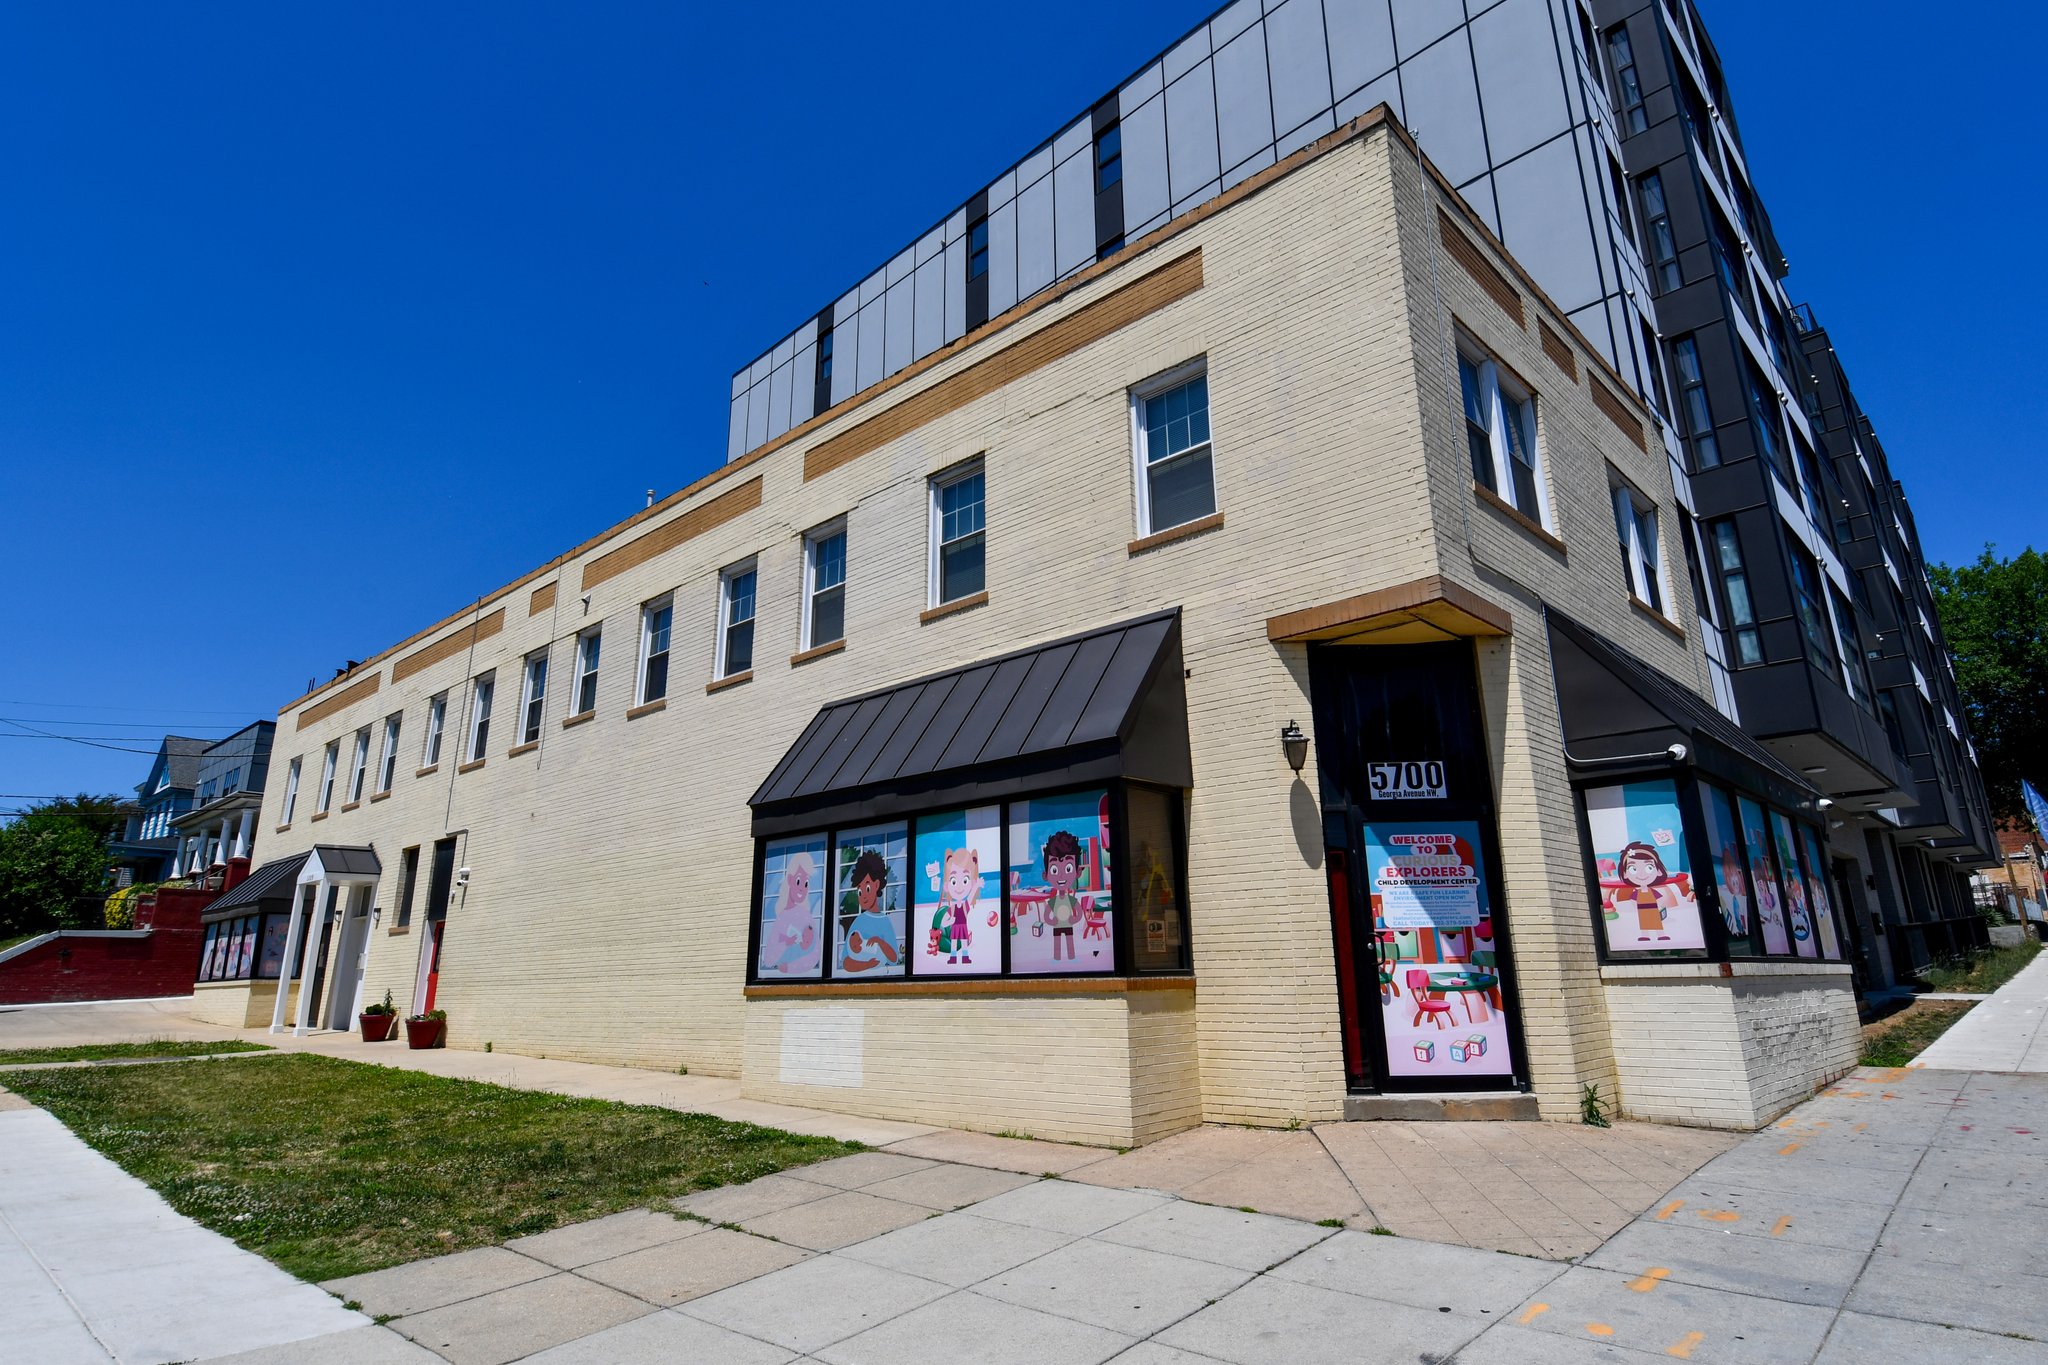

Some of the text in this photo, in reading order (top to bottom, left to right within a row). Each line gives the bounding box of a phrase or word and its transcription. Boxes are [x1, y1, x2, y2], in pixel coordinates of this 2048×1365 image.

[1369, 762, 1444, 790] 5700
[1378, 790, 1402, 799] Georgia
[1403, 789, 1425, 797] Avenue
[1392, 835, 1453, 844] WELCOME
[1416, 845, 1433, 854] TO
[1393, 855, 1458, 866] CURIOUS
[1386, 866, 1467, 877] EXPLORERS
